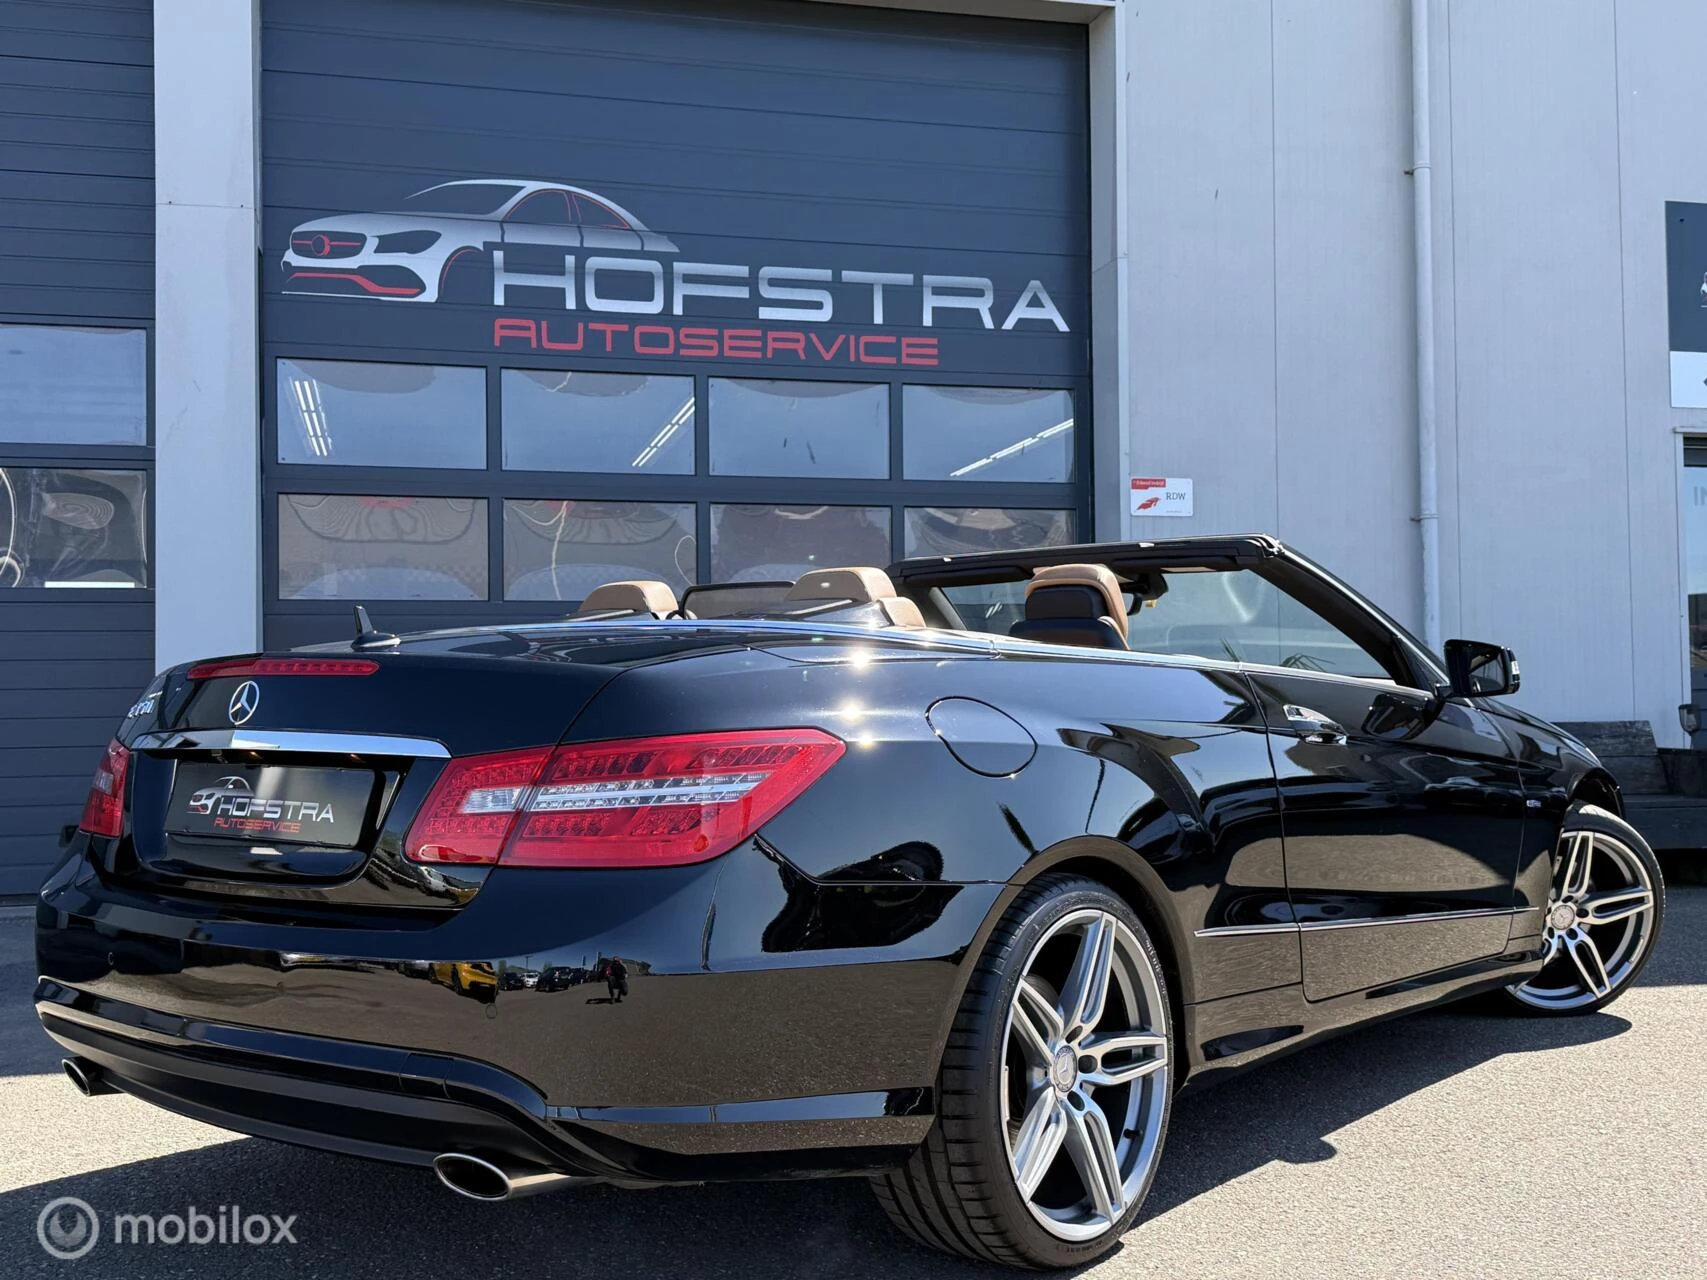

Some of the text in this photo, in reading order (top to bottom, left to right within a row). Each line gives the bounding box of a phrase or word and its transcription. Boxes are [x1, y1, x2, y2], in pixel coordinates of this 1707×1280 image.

[493, 250, 1071, 333] HOFSTRA
[494, 318, 939, 366] AUTOSERVICE
[1166, 491, 1186, 501] RDW
[217, 796, 335, 823] HOFSTRA
[214, 817, 301, 833] AUTOSERVICE
